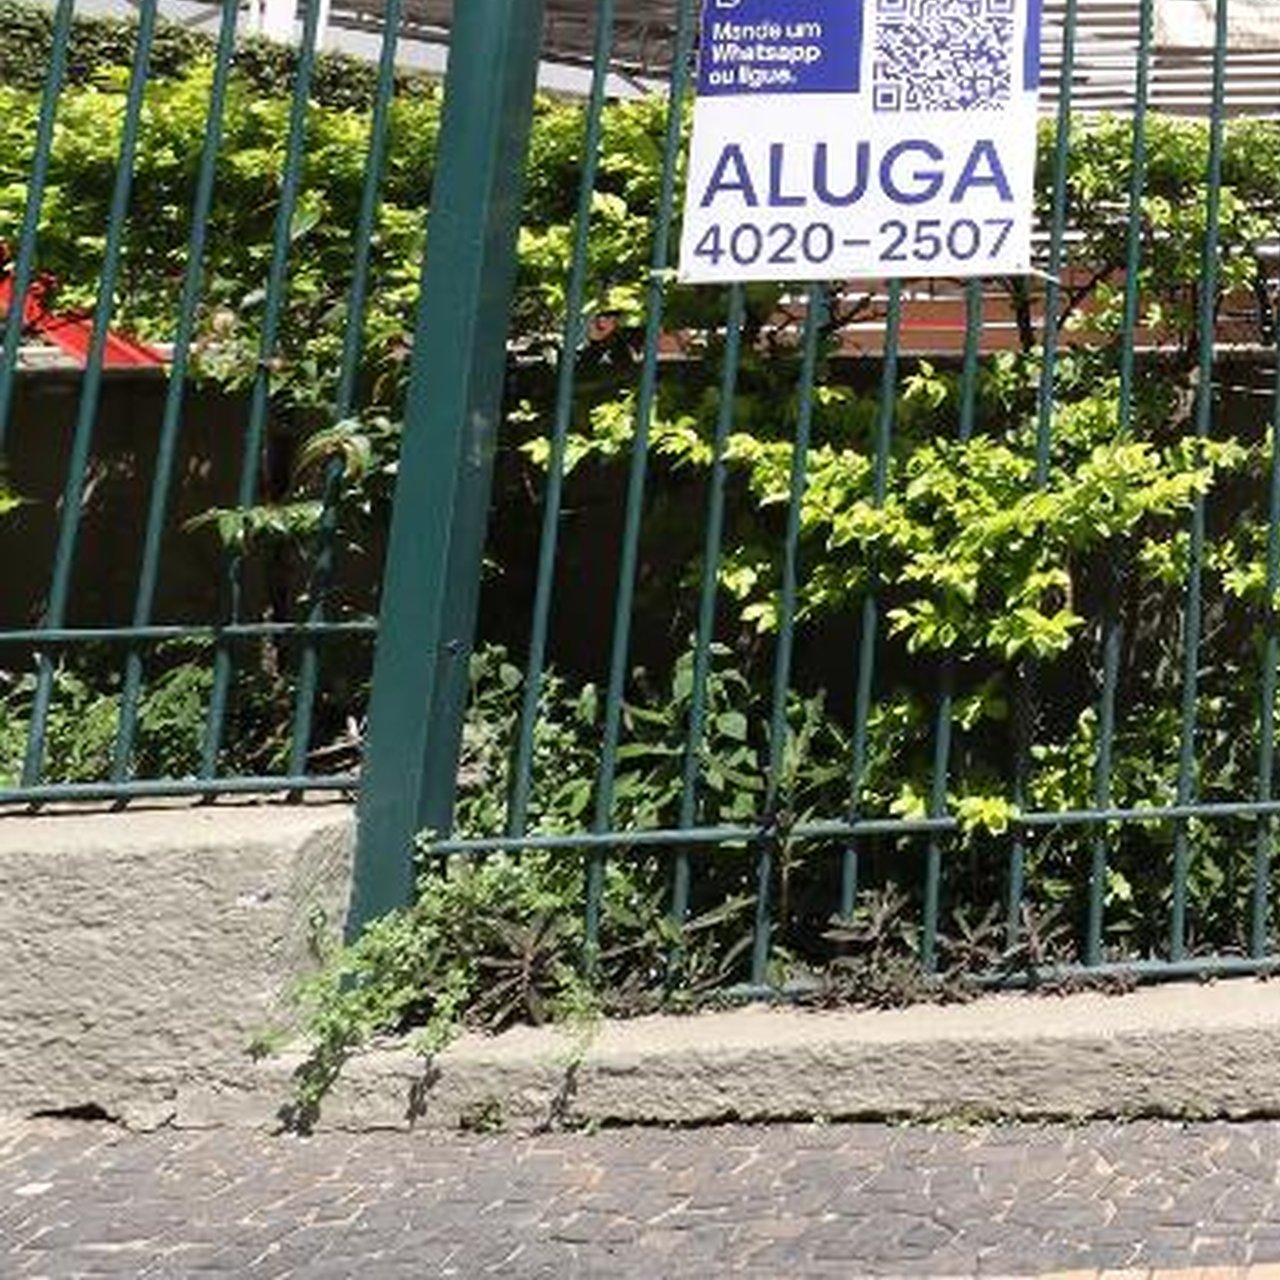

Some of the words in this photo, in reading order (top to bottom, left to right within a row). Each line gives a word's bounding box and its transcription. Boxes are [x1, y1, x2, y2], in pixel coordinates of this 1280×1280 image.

[712, 21, 782, 41] Mande
[786, 22, 822, 38] um
[712, 43, 822, 65] Whatsapp
[708, 69, 734, 85] ou
[700, 139, 1015, 208] ALUGA
[693, 217, 1015, 265] 4020-2507
